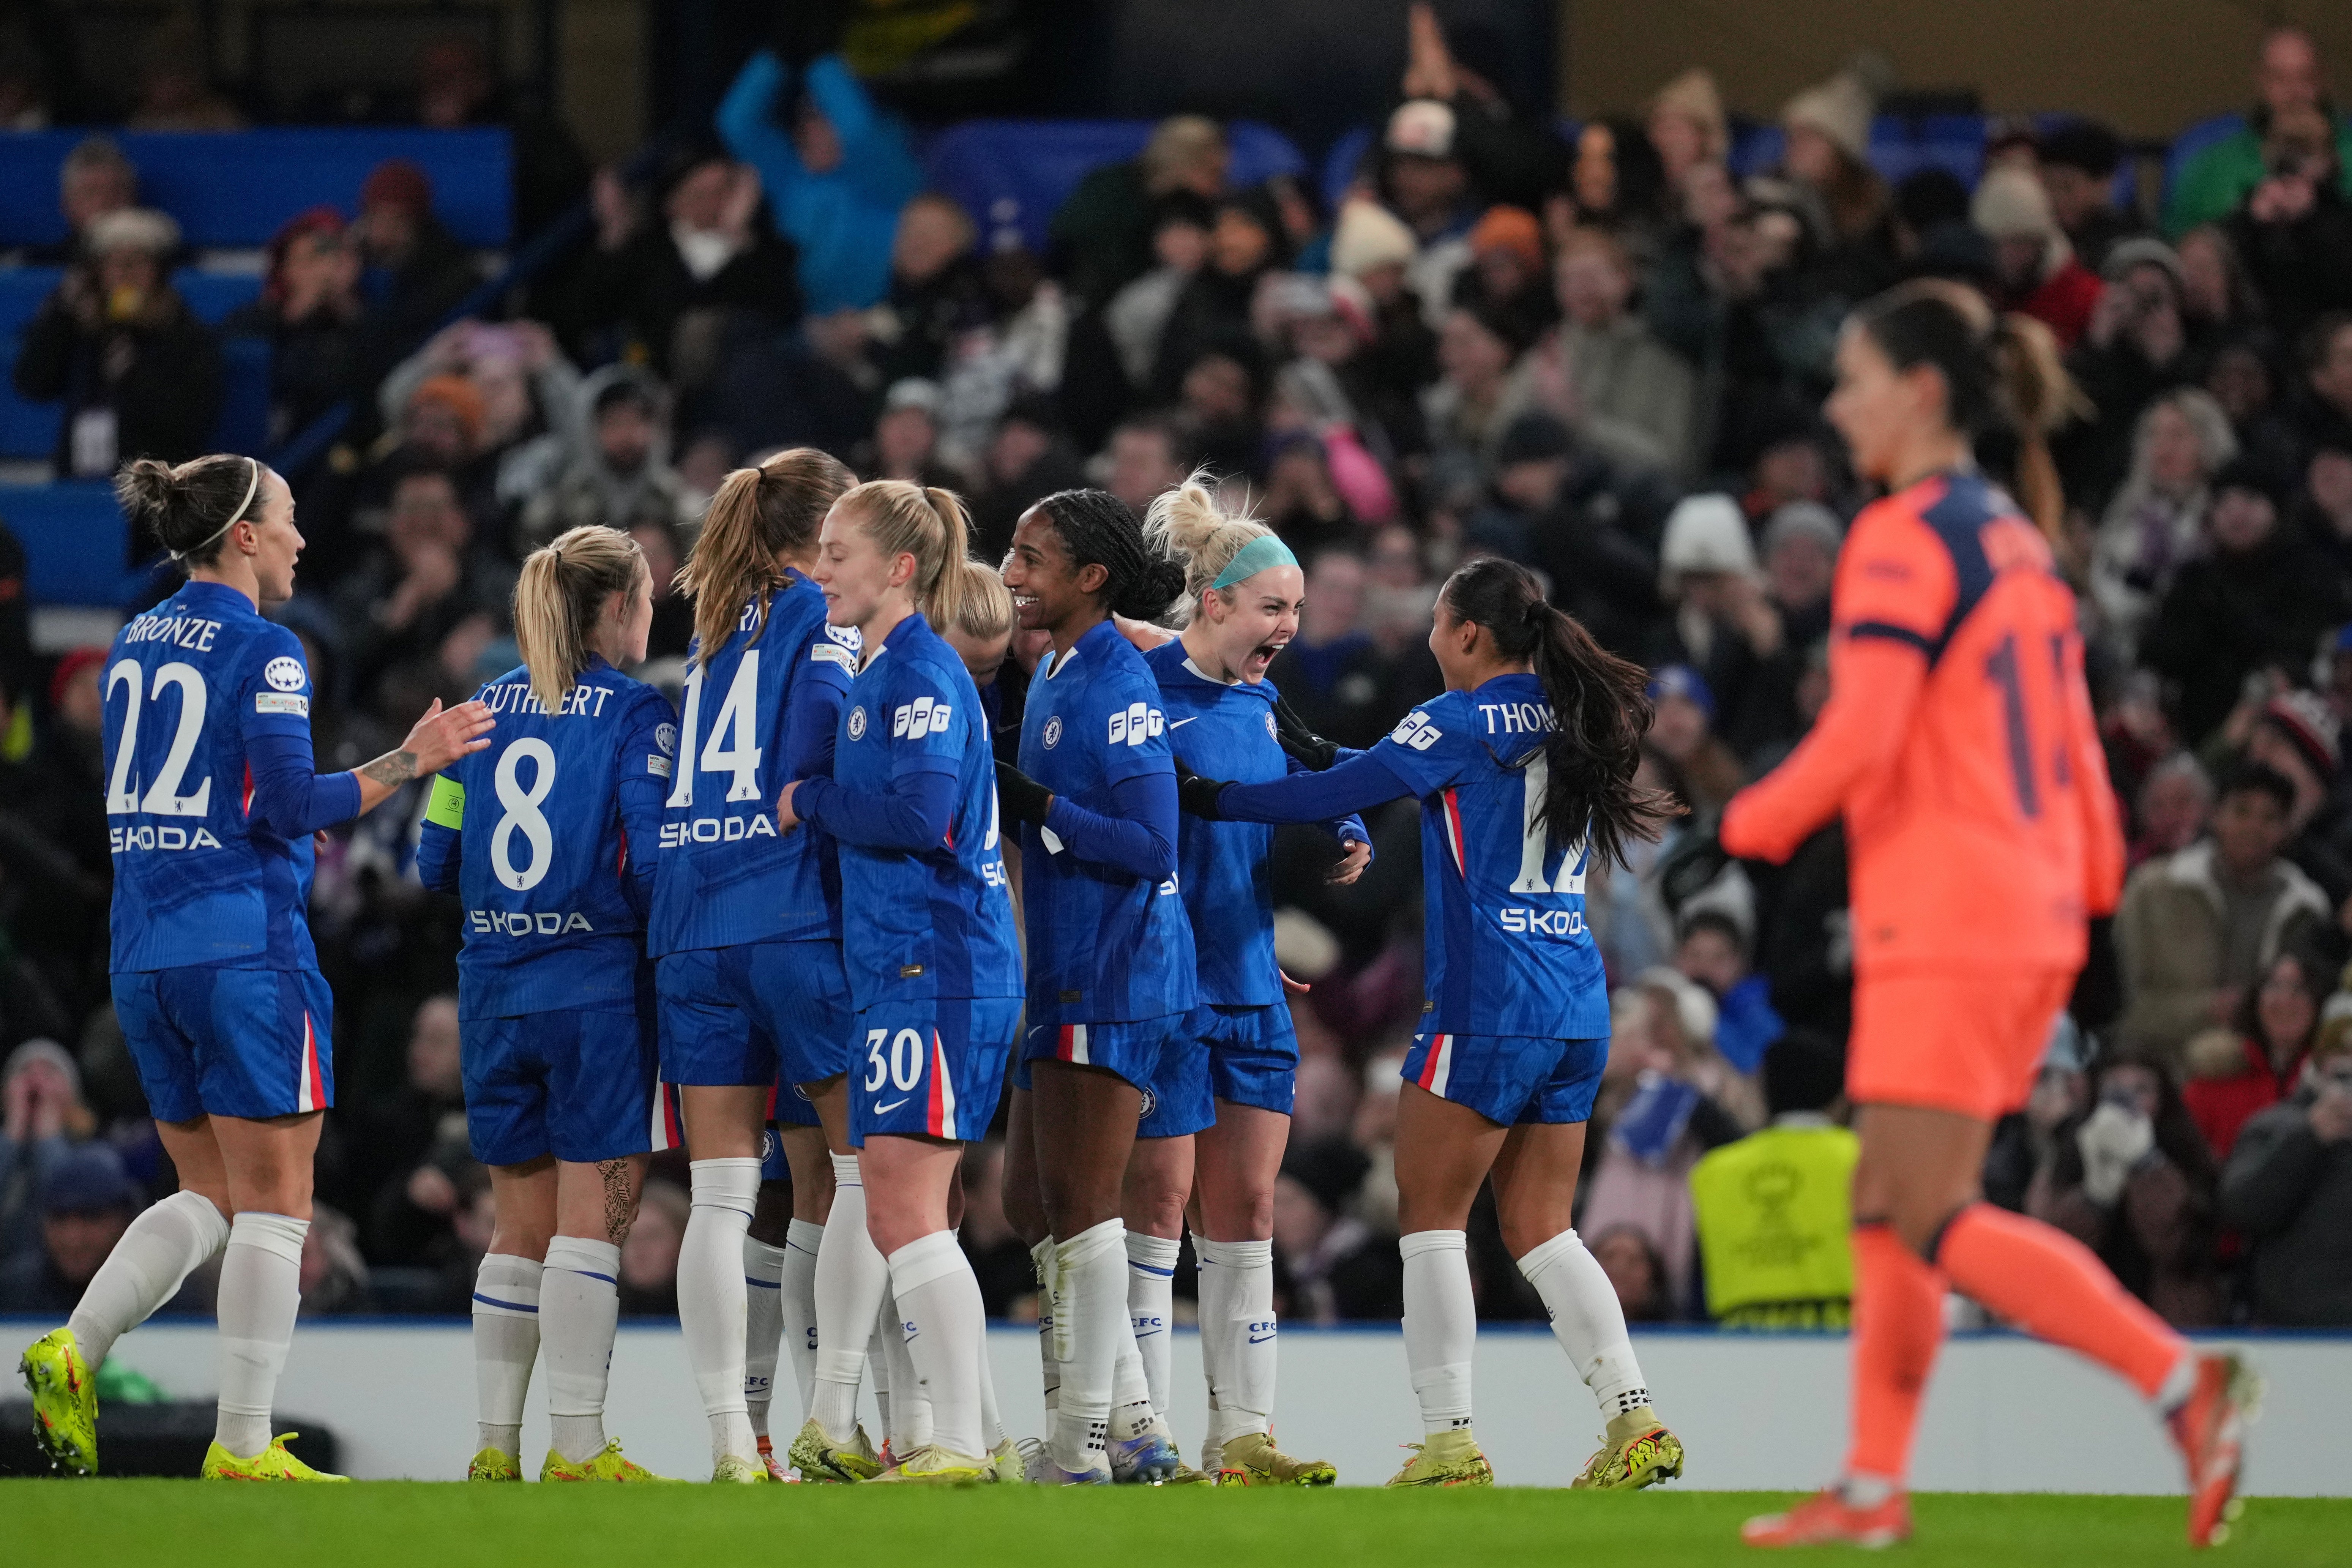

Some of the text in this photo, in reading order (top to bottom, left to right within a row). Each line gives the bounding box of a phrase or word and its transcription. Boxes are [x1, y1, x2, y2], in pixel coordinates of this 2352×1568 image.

[125, 615, 221, 652] BRONZE
[480, 684, 614, 717] CUTHERT
[666, 649, 762, 808] 14
[1478, 703, 1564, 734] THOM
[106, 658, 211, 817] 22
[491, 737, 556, 891] 8
[1500, 908, 1589, 934] SKOD
[865, 1028, 923, 1092] 30
[1249, 1322, 1276, 1332] CFC
[745, 1376, 768, 1386] FC
